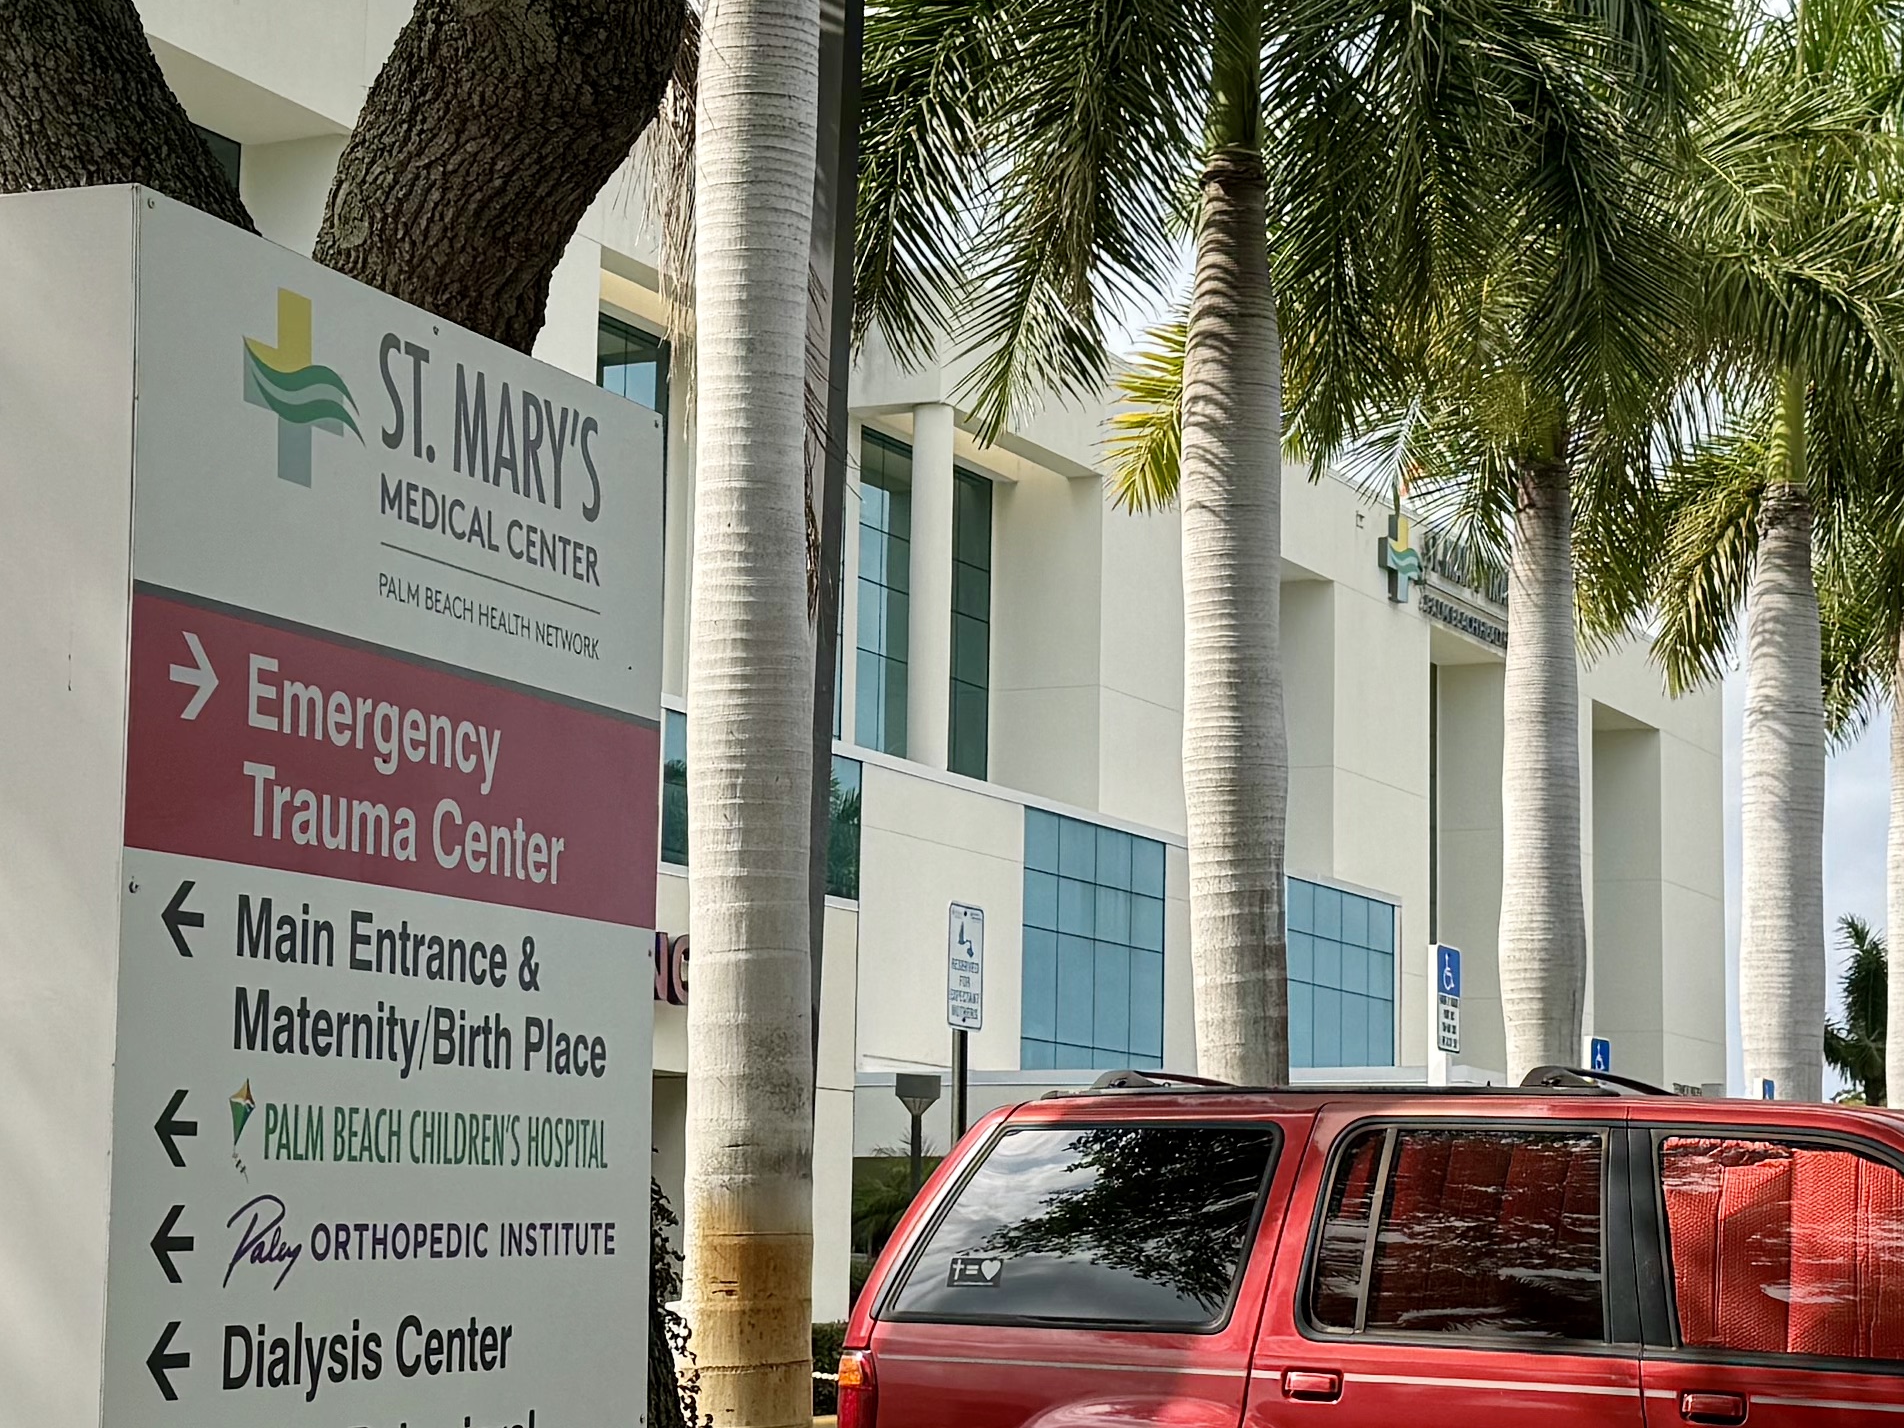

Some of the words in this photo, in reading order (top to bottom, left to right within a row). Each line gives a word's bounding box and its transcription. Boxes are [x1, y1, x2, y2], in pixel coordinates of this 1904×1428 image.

[379, 331, 435, 464] ST.
[453, 361, 601, 523] MARY'S
[380, 472, 499, 553] MEDICAL
[507, 519, 600, 587] CENTER
[379, 572, 421, 608] PALM
[425, 583, 474, 623] BEACH
[478, 603, 531, 639] HEALTH
[536, 619, 600, 660] NETWORK
[247, 652, 501, 794] Emergency
[243, 761, 417, 862] Trauma
[433, 797, 565, 886] Center
[236, 893, 335, 968] Main
[348, 909, 508, 988] Entrance
[517, 935, 541, 992] &
[233, 986, 512, 1079] Maternity/Birth
[524, 1016, 608, 1079] Place
[263, 1103, 325, 1163] PALM
[332, 1106, 403, 1165] BEACH
[409, 1110, 521, 1169] CHILDREN'S
[527, 1116, 609, 1170] HOSPITAL
[222, 1194, 303, 1291] Paley
[310, 1221, 489, 1261] ORTHOPEDIC
[499, 1221, 617, 1259] INSTITUTE
[222, 1319, 383, 1402] Dialysis
[396, 1314, 513, 1379] Center
